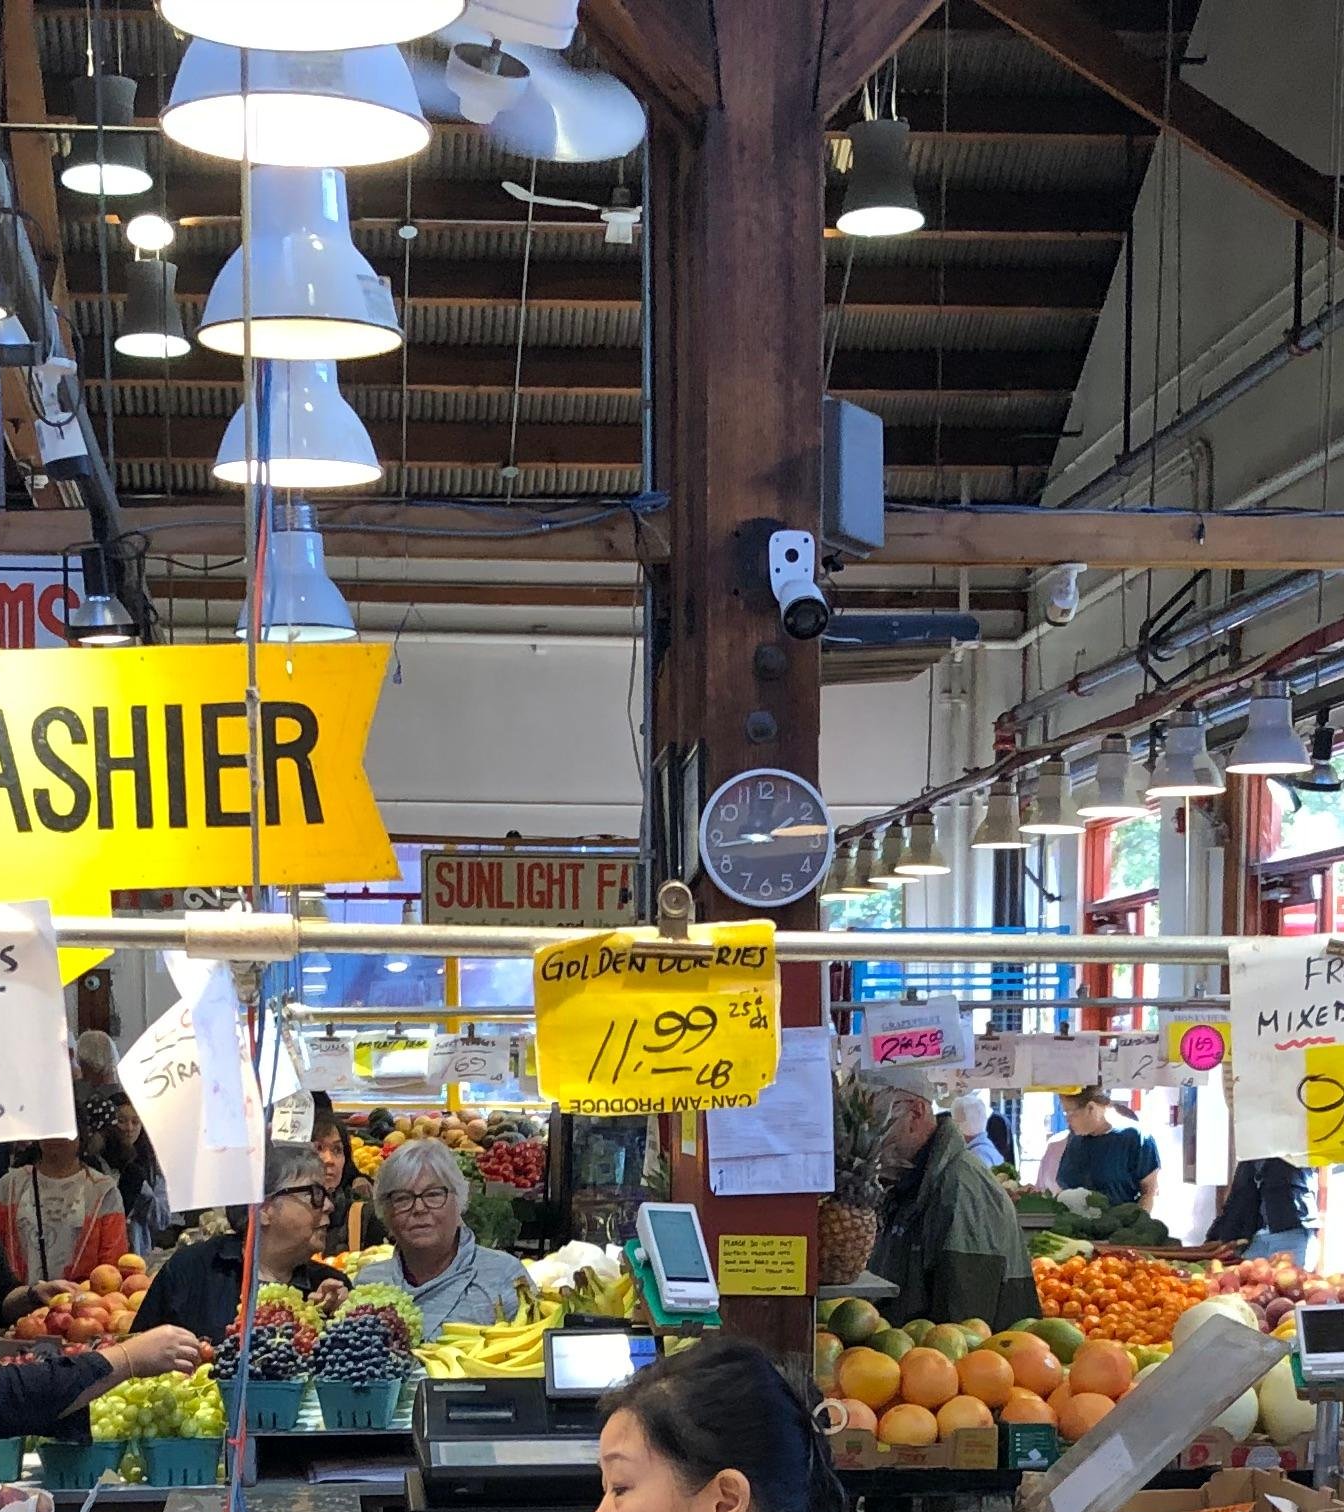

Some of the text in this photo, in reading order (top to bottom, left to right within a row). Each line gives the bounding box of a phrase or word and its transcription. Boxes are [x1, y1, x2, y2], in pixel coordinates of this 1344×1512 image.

[435, 861, 585, 910] SUNLIGHT
[542, 946, 646, 982] GOLDEN
[570, 1092, 753, 1113] CAN-AM PRODUCE
